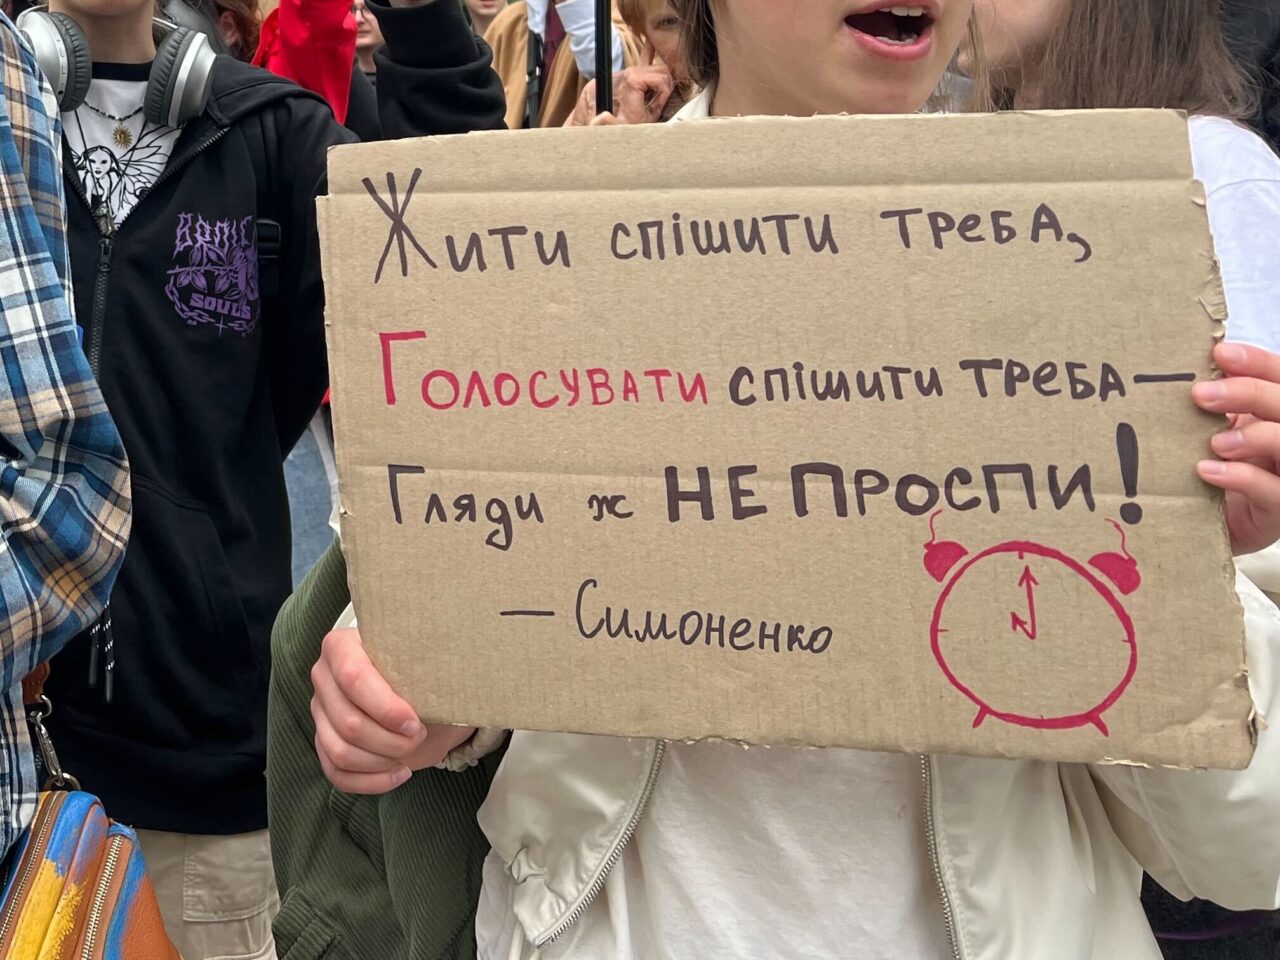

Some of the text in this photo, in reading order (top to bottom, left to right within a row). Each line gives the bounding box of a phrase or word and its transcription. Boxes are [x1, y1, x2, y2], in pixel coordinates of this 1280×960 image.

[361, 168, 571, 284] Жити
[610, 212, 840, 261] спішити
[387, 464, 545, 551] Гляди
[587, 494, 634, 523] ж
[664, 464, 768, 523] НЕ
[574, 578, 834, 654] Симоненко
